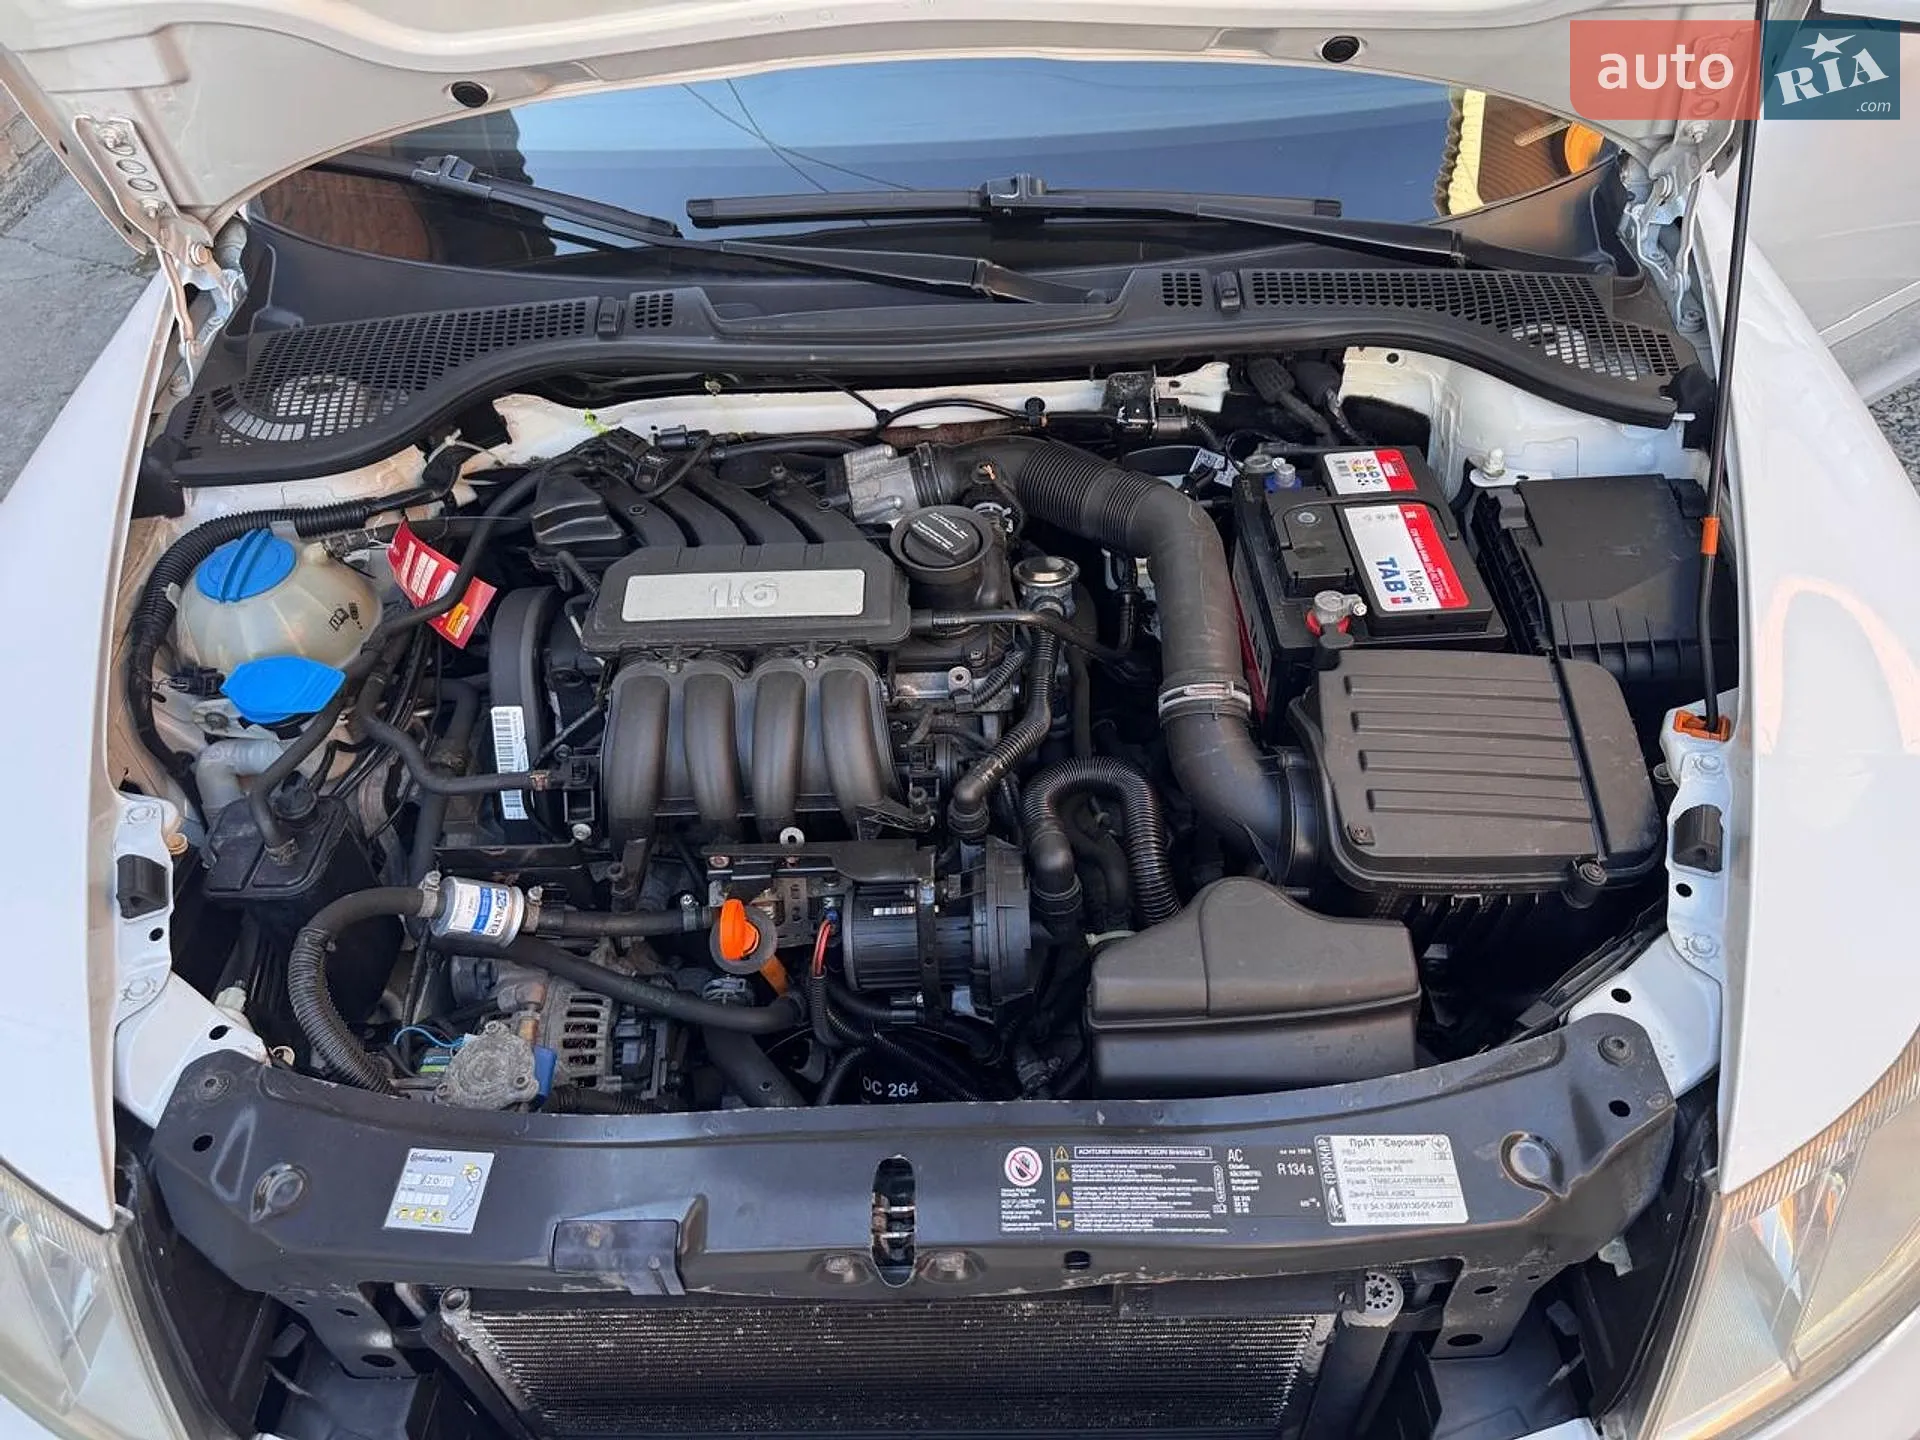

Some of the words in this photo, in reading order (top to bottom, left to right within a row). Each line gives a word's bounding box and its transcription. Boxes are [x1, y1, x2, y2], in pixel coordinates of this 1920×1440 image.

[1376, 556, 1408, 593] TAB
[1405, 569, 1432, 603] Magic
[862, 1075, 883, 1096] OC
[887, 1080, 920, 1098] 264
[1227, 1148, 1244, 1163] AC
